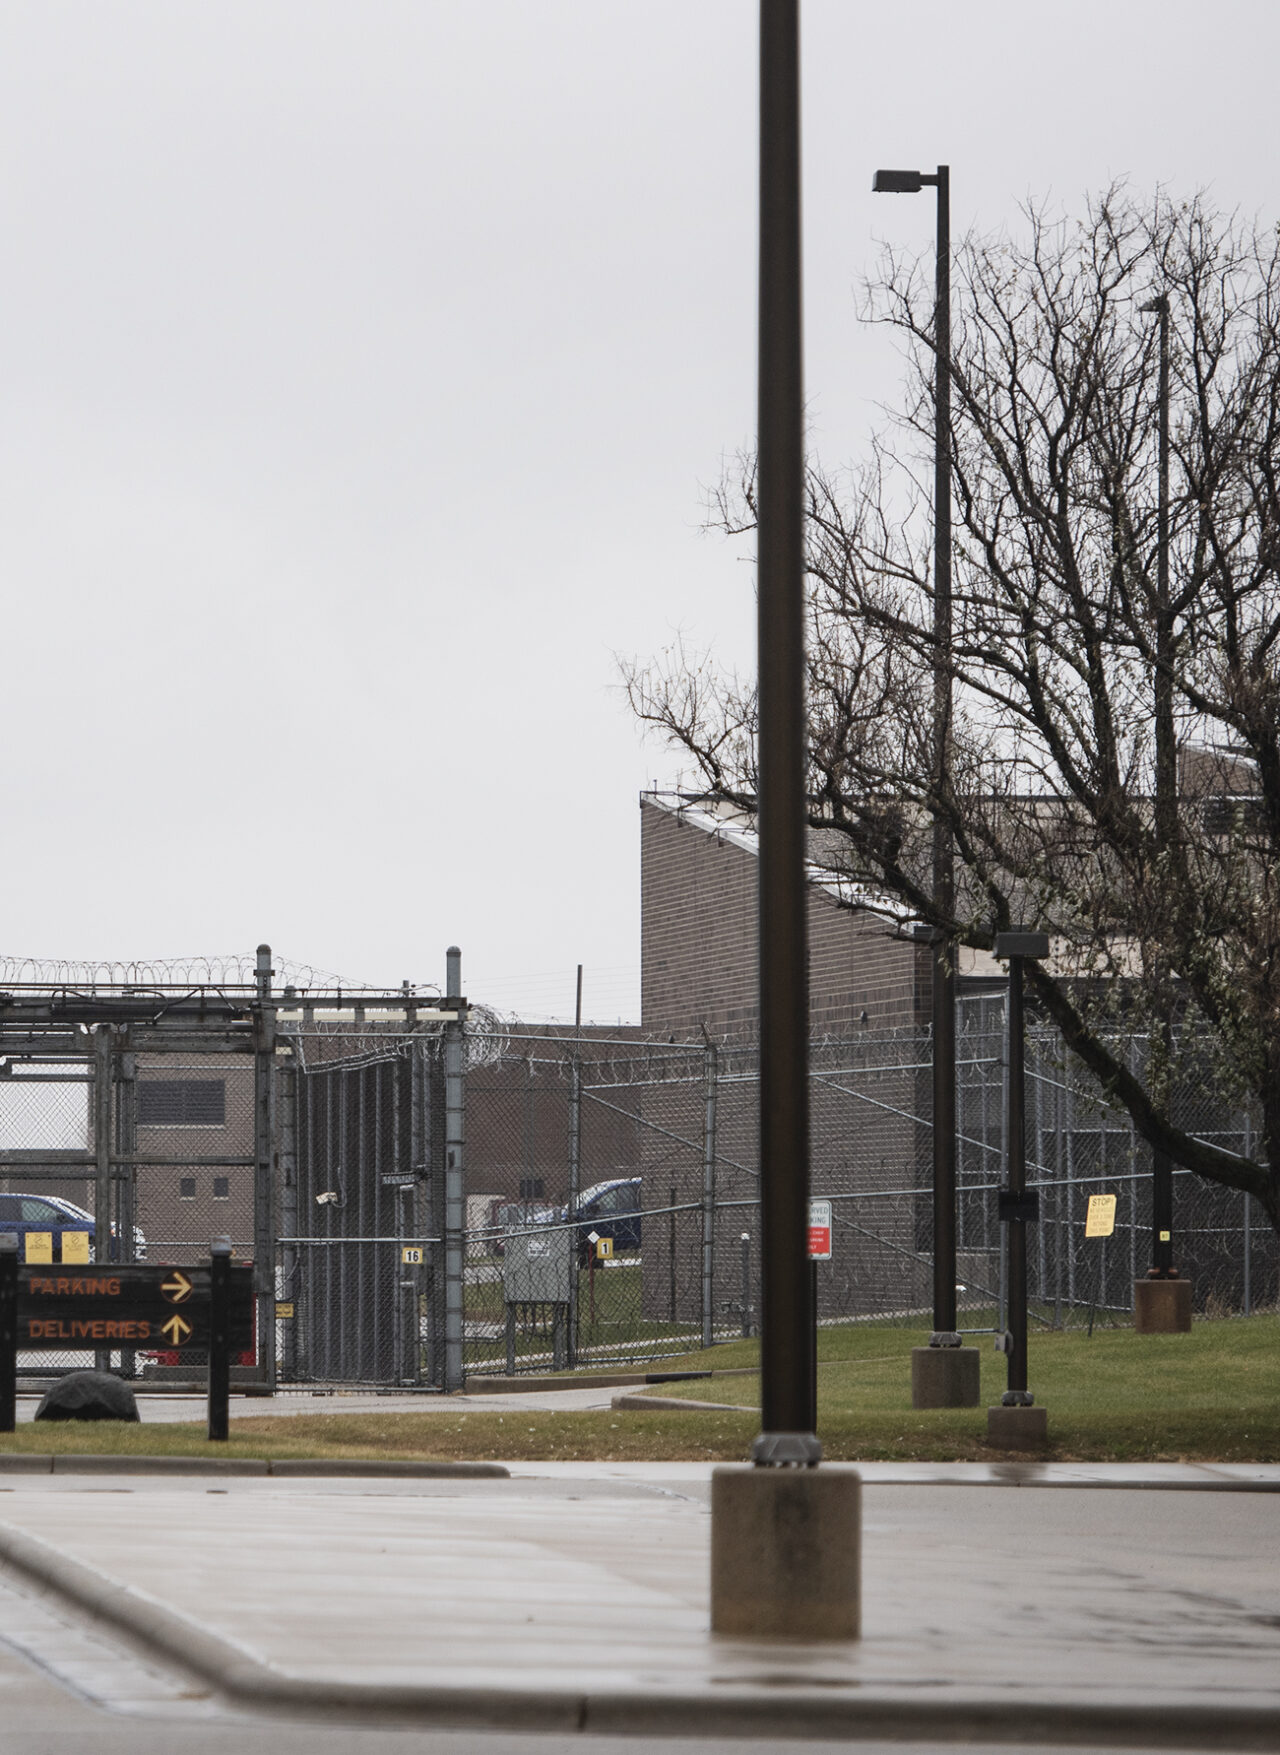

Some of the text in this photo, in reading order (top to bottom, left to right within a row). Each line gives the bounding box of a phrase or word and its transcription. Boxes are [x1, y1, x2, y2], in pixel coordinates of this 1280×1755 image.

[407, 1250, 419, 1262] 16
[29, 1277, 121, 1295] PARKING
[29, 1319, 151, 1338] DELIVERIES
